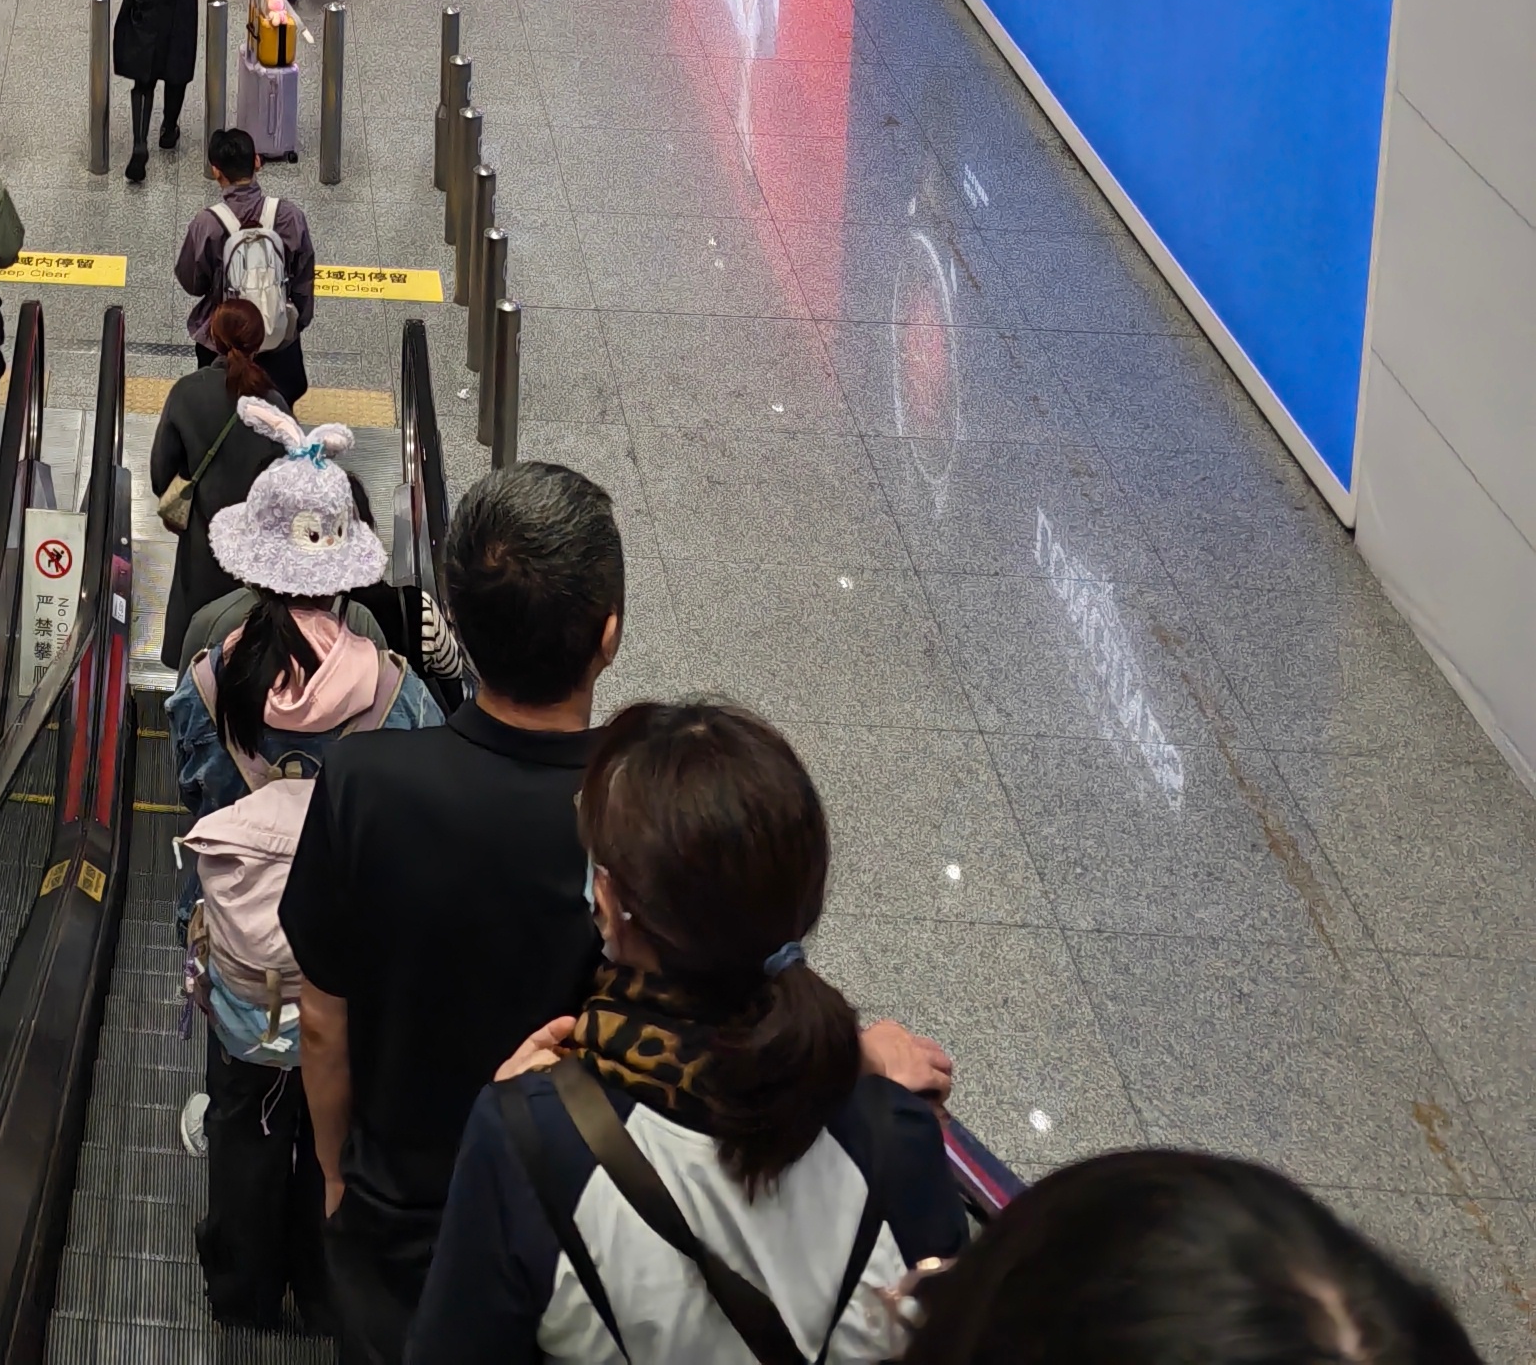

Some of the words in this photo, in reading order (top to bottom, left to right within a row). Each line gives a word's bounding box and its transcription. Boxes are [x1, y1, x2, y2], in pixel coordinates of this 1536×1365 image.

[30, 268, 71, 279] Clear
[344, 284, 385, 294] Clear
[56, 597, 70, 617] No
